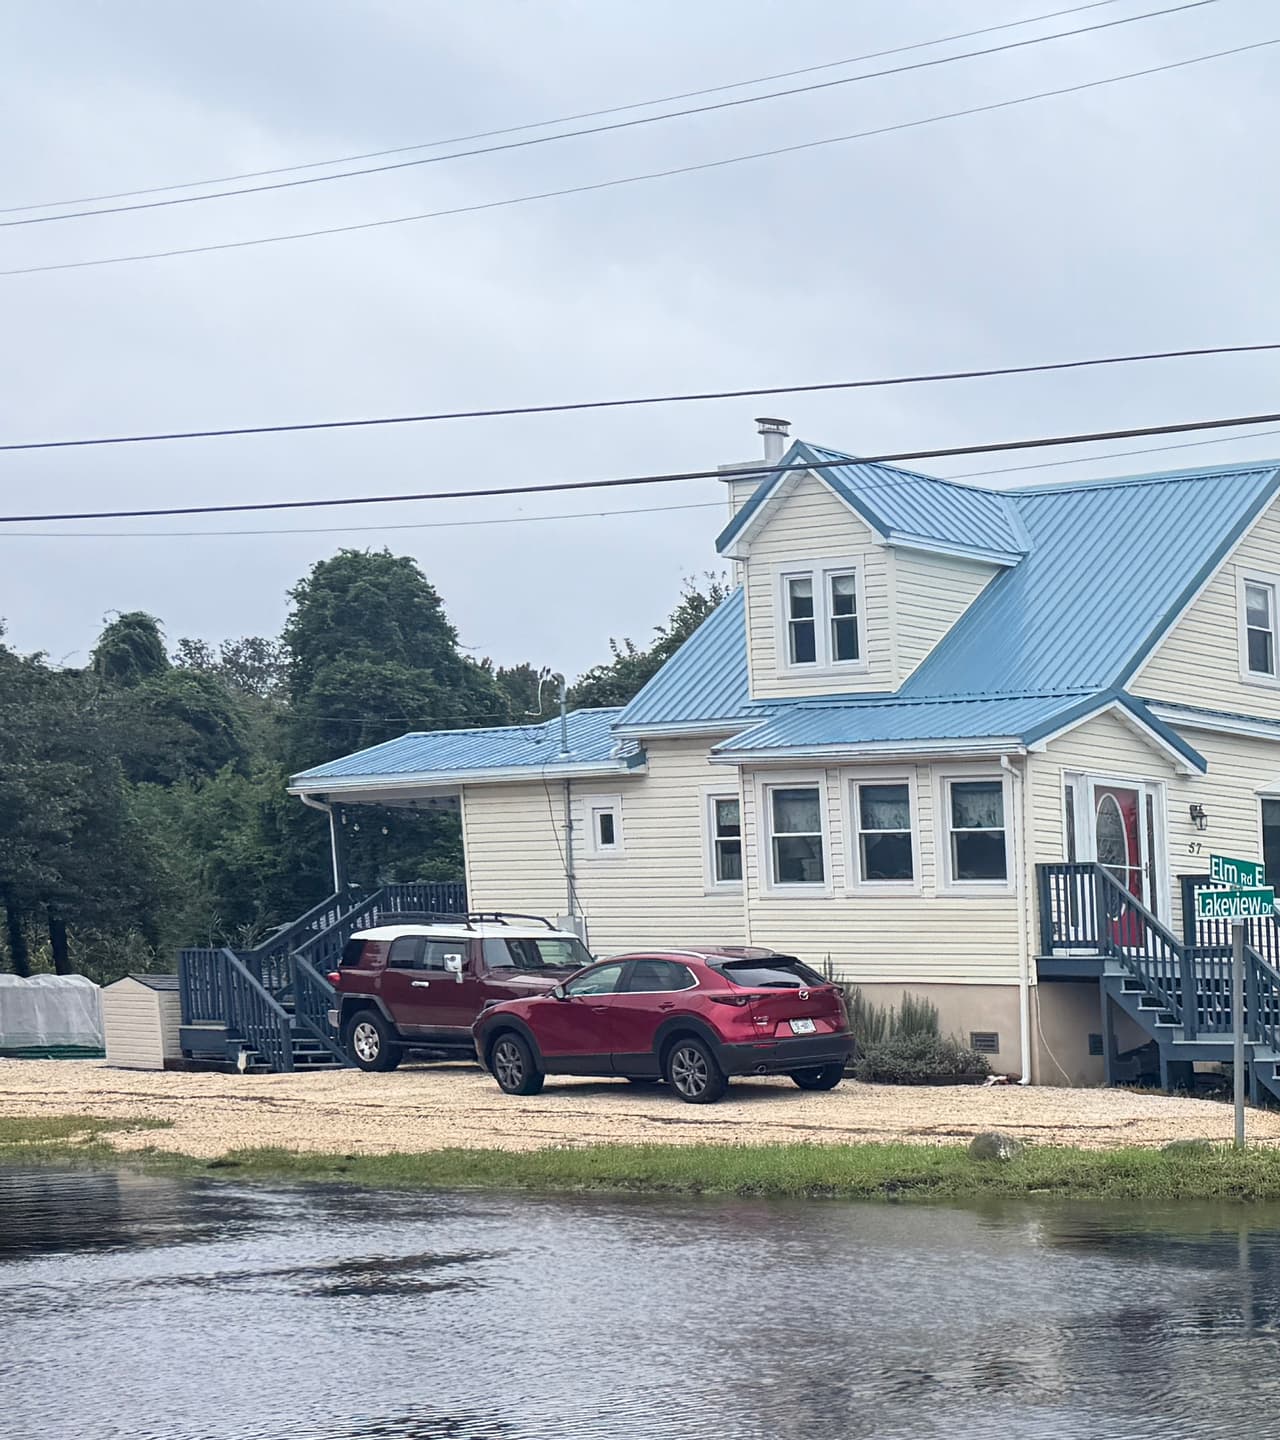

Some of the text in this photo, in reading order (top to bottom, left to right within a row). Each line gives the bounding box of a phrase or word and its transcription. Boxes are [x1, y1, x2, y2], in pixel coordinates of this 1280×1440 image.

[1188, 842, 1202, 854] 57
[1212, 857, 1263, 887] Elm Rd E
[1199, 891, 1273, 917] Lakeview Dr
